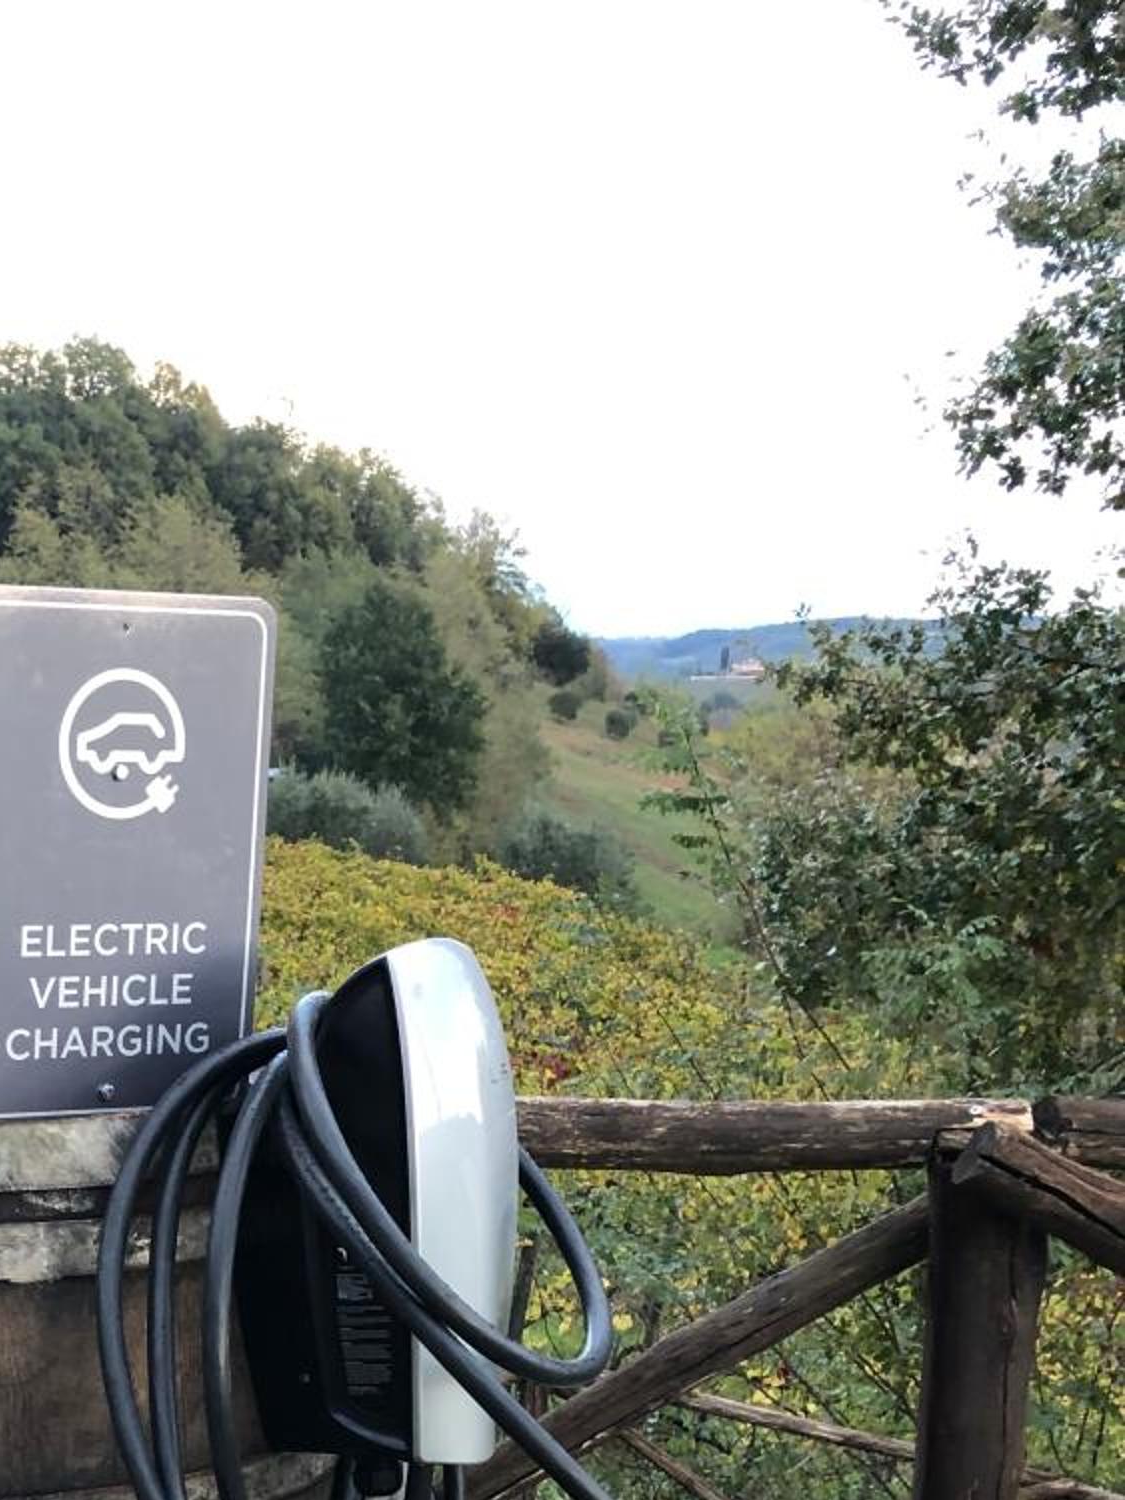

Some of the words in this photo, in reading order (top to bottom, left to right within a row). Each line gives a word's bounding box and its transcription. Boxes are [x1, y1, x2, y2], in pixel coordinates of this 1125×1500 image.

[20, 922, 207, 958] ELECTRIC
[29, 973, 193, 1009] VEHICLE
[5, 1022, 210, 1061] CHARGING
